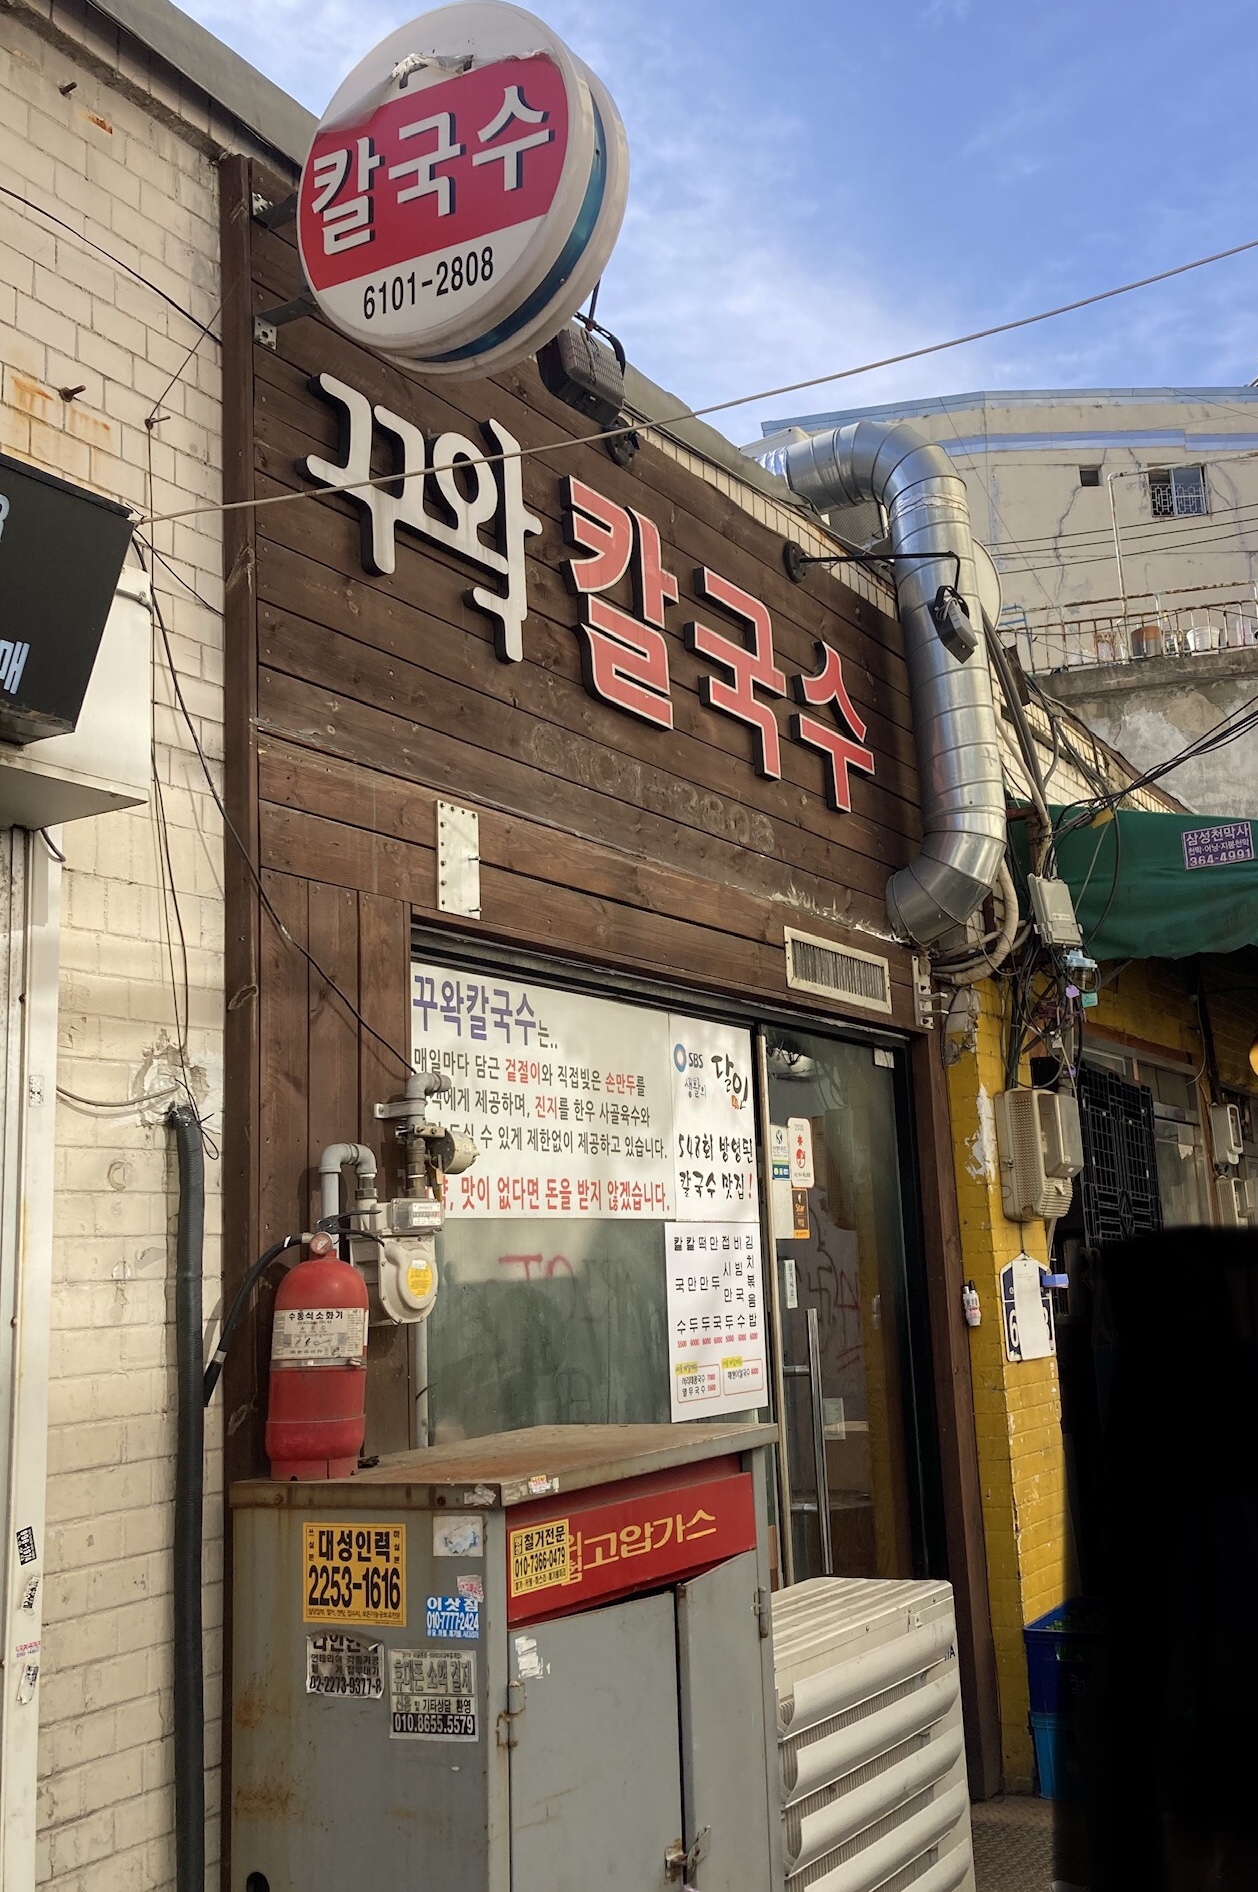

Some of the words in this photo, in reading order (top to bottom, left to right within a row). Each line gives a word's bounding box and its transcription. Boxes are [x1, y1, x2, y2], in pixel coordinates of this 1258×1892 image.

[311, 84, 556, 256] 칼국수
[363, 246, 494, 320] 6101-2808
[302, 372, 543, 663] 꾸왁
[566, 475, 876, 813] 칼국수
[1186, 823, 1249, 846] 삼성천막사
[1190, 848, 1250, 867] 364-4991
[414, 1048, 470, 1079] 매일마다
[475, 1054, 499, 1080] 담근
[505, 1058, 553, 1086] 겉절이와
[557, 1065, 602, 1091] 직접빚은
[605, 1072, 645, 1097] 손만두를
[688, 1052, 704, 1069] SBS
[475, 1090, 531, 1119] 제공하며,
[573, 1099, 596, 1122] 한우
[599, 1102, 650, 1128] 사골육수와
[480, 1126, 493, 1149] 수
[498, 1127, 523, 1151] 있게
[527, 1129, 573, 1154] 제한없이
[577, 1133, 621, 1157] 제공하고
[624, 1137, 668, 1160] 있습니다.
[719, 1136, 754, 1163] 방영된
[461, 1176, 490, 1210] 맛이
[497, 1177, 541, 1211] 없다면
[545, 1178, 573, 1211] 돈을
[577, 1179, 602, 1211] 받지
[607, 1180, 670, 1213] 않겠습니다.
[679, 1170, 716, 1198] 칼국수
[318, 1529, 391, 1563] 대성인력
[524, 1526, 566, 1551] 철거전문
[584, 1508, 717, 1569] 고압가스
[515, 1546, 566, 1578] 010-7366-0479
[308, 1564, 401, 1610] 2253-1616
[427, 1597, 478, 1612] 이삿짐
[427, 1611, 480, 1630] 010-7777-2424
[423, 1698, 451, 1713] 기타상담
[456, 1698, 471, 1713] 환영
[394, 1713, 474, 1734] 010.8655.5579
